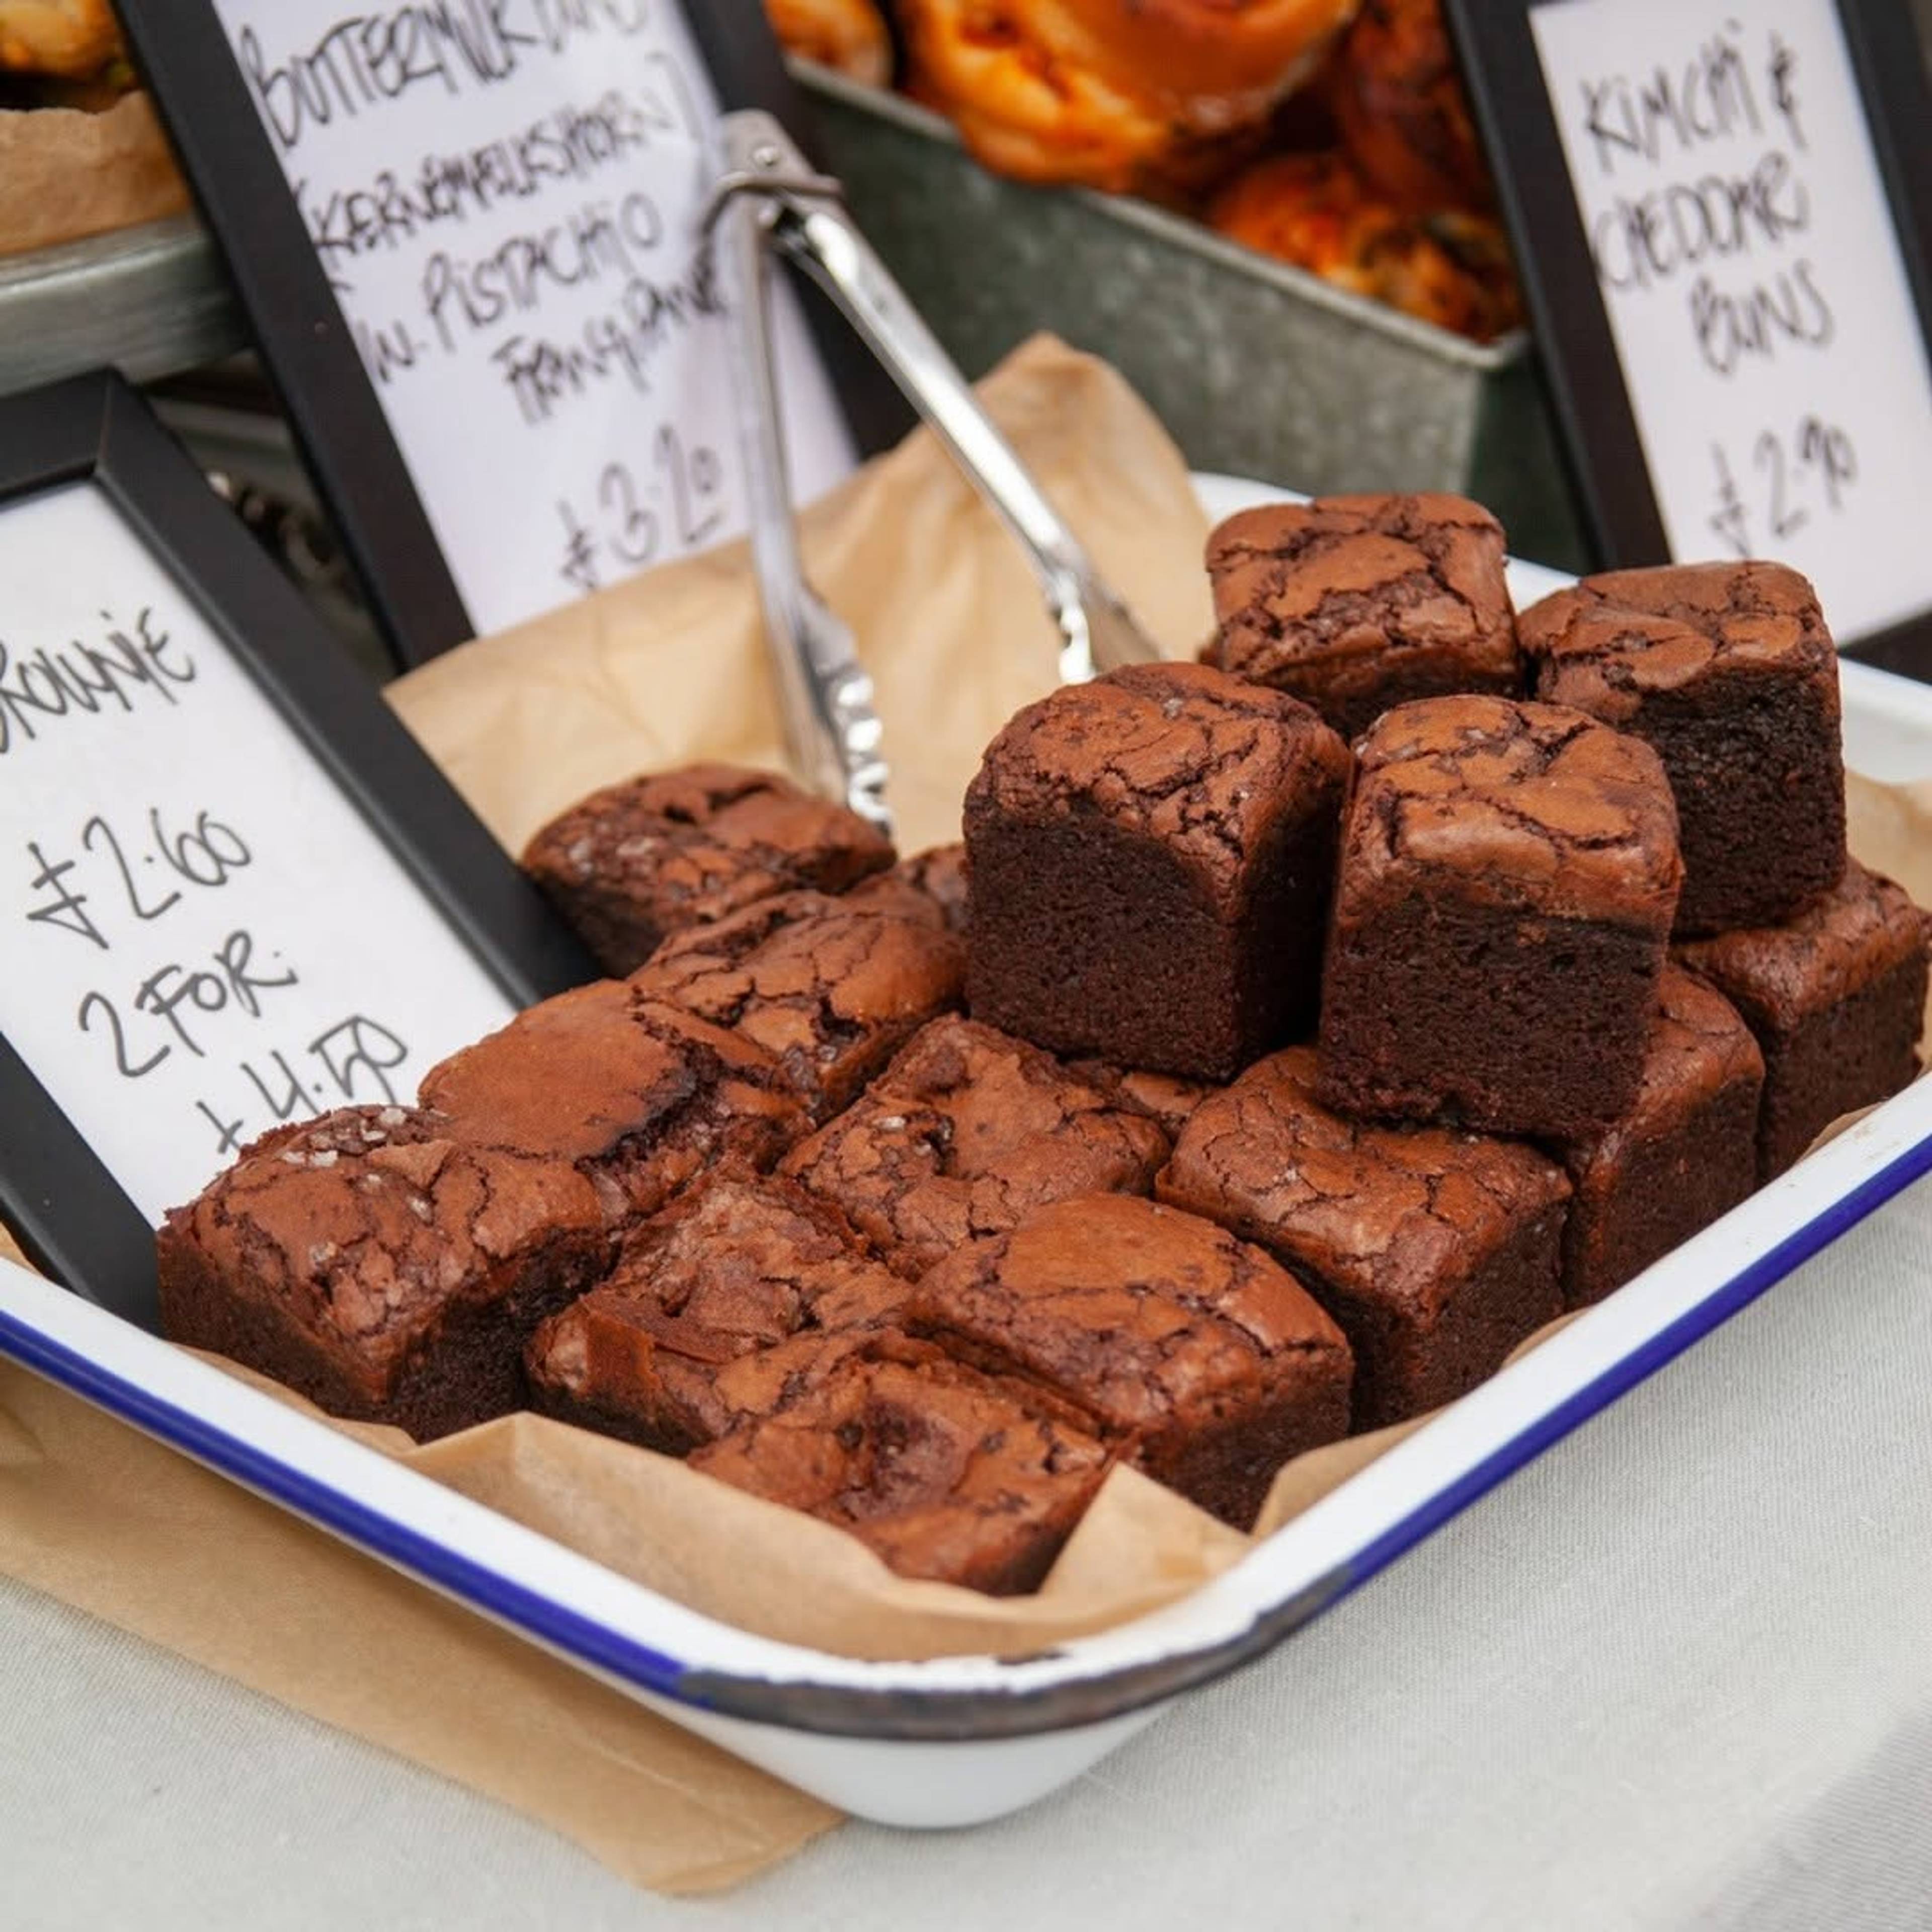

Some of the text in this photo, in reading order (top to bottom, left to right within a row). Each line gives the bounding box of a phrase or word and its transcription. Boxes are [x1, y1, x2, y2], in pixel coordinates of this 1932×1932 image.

[1592, 150, 1810, 290] CHEDDAR
[1687, 258, 1836, 378] BUNS
[555, 425, 727, 591] £3.20
[1708, 411, 1860, 561] £2.90
[0, 607, 196, 754] ROWNIE
[27, 807, 252, 951] £2.60
[78, 989, 172, 1079] 2
